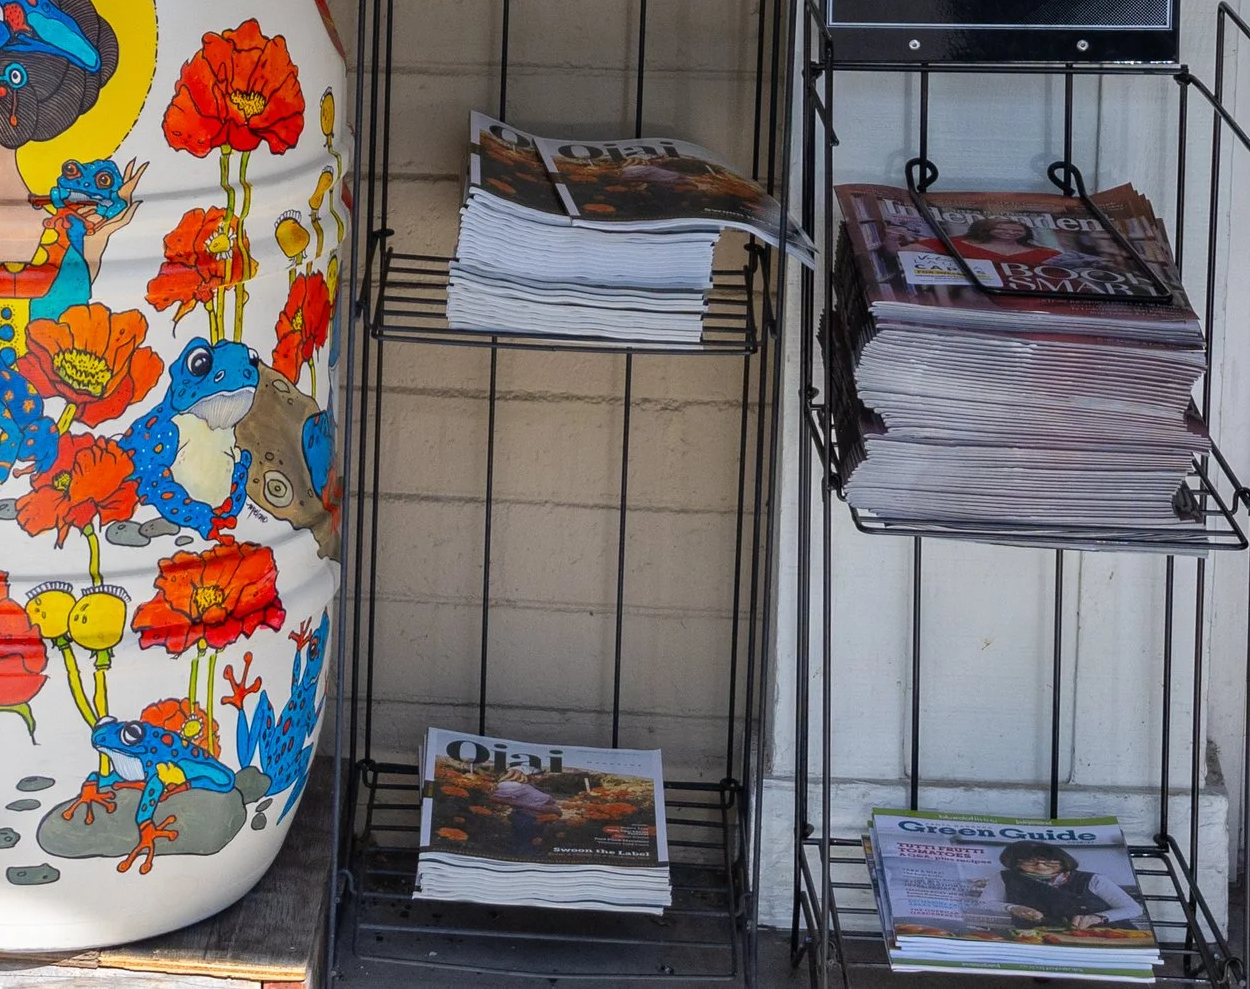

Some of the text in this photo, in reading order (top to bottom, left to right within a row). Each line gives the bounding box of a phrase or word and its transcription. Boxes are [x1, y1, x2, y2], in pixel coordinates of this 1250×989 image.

[898, 820, 996, 839] Green
[999, 828, 1097, 842] Guide
[553, 846, 593, 854] Swoon
[595, 848, 616, 856] the
[897, 842, 985, 854] TUTTI FRUTTI
[898, 847, 972, 858] TOMATOES
